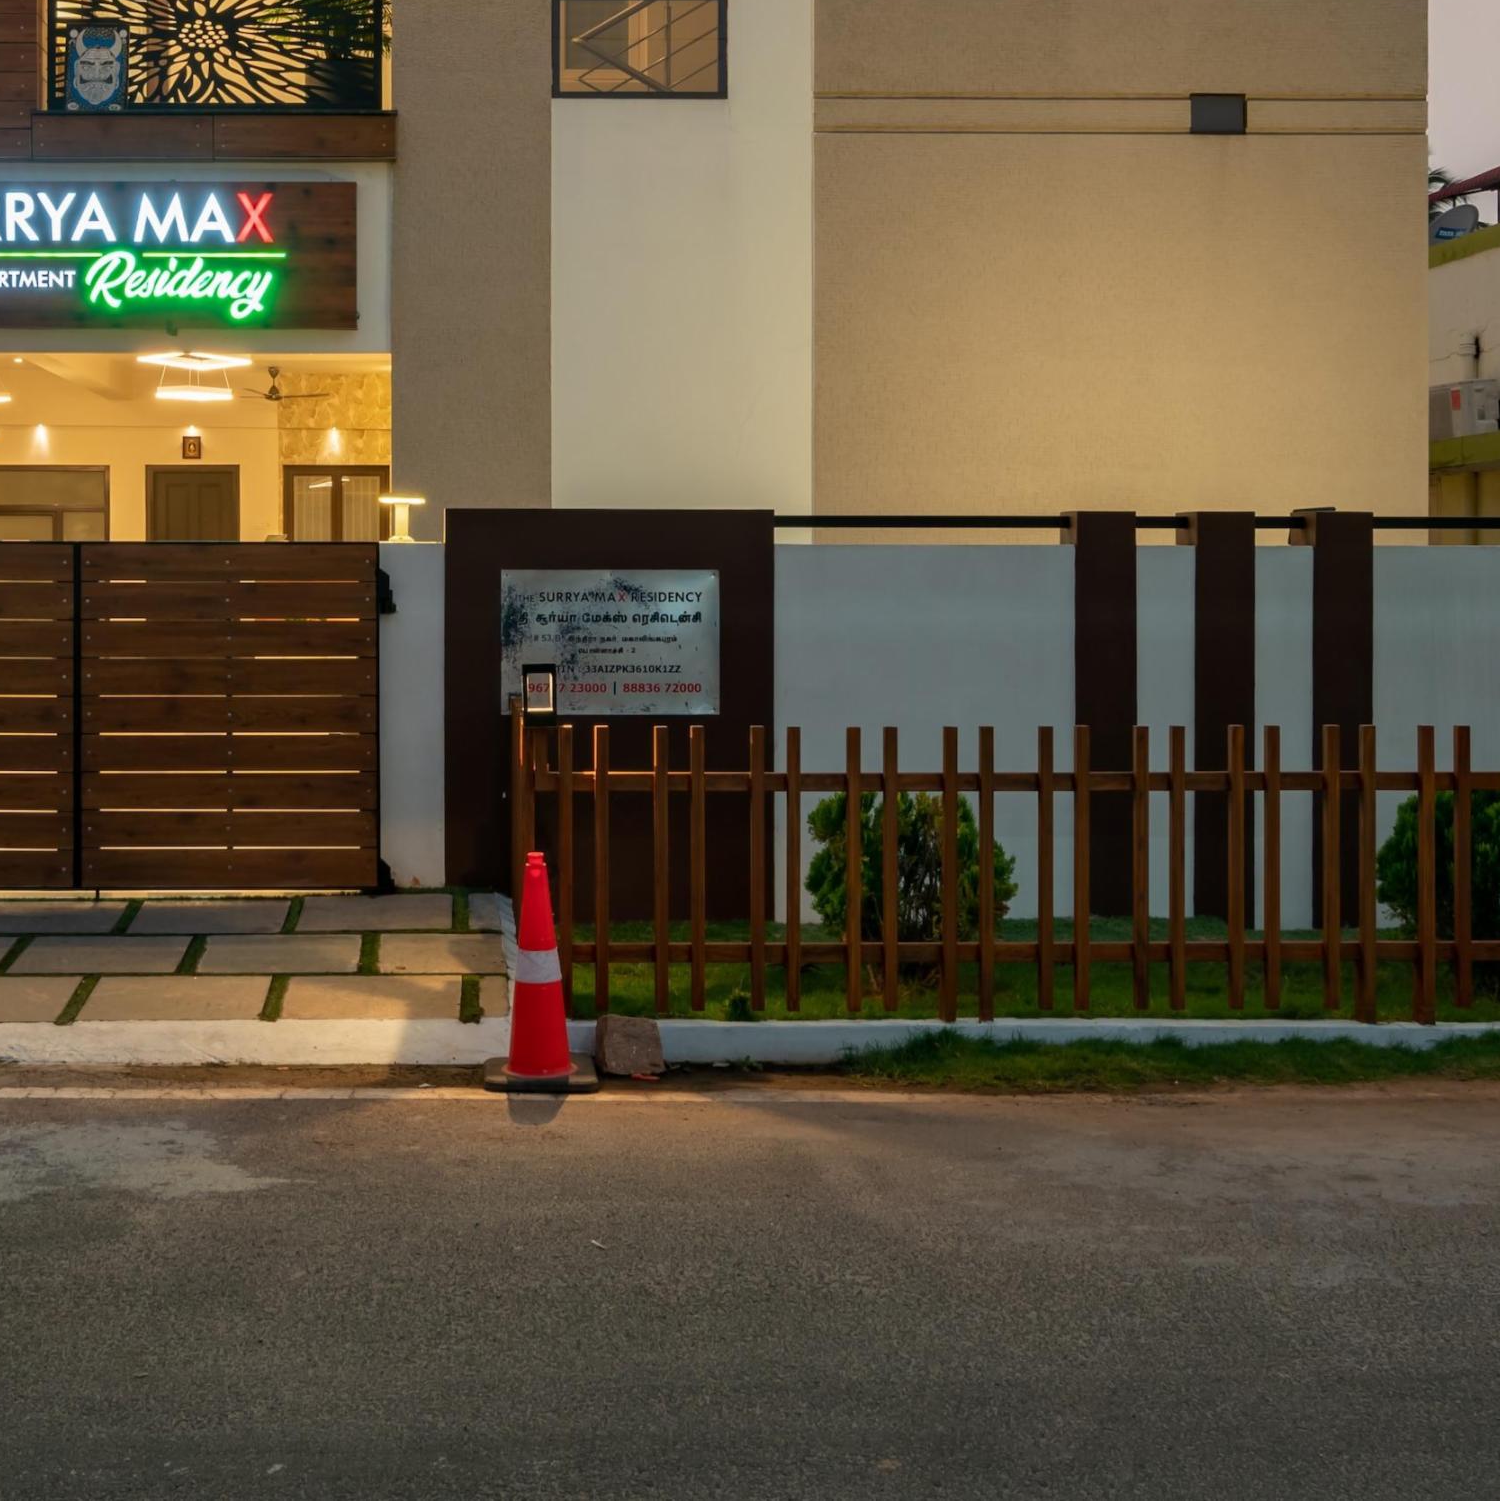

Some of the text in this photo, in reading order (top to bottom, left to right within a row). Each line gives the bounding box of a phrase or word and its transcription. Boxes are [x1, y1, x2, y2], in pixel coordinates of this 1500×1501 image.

[133, 191, 274, 243] MAX
[85, 250, 274, 320] Residency
[518, 591, 703, 603] THE SURRYA MAX RESIDENCY
[535, 611, 577, 626] சூர்யா
[570, 682, 607, 693] 23000
[623, 682, 661, 693] 88836
[664, 682, 702, 693] 72000
